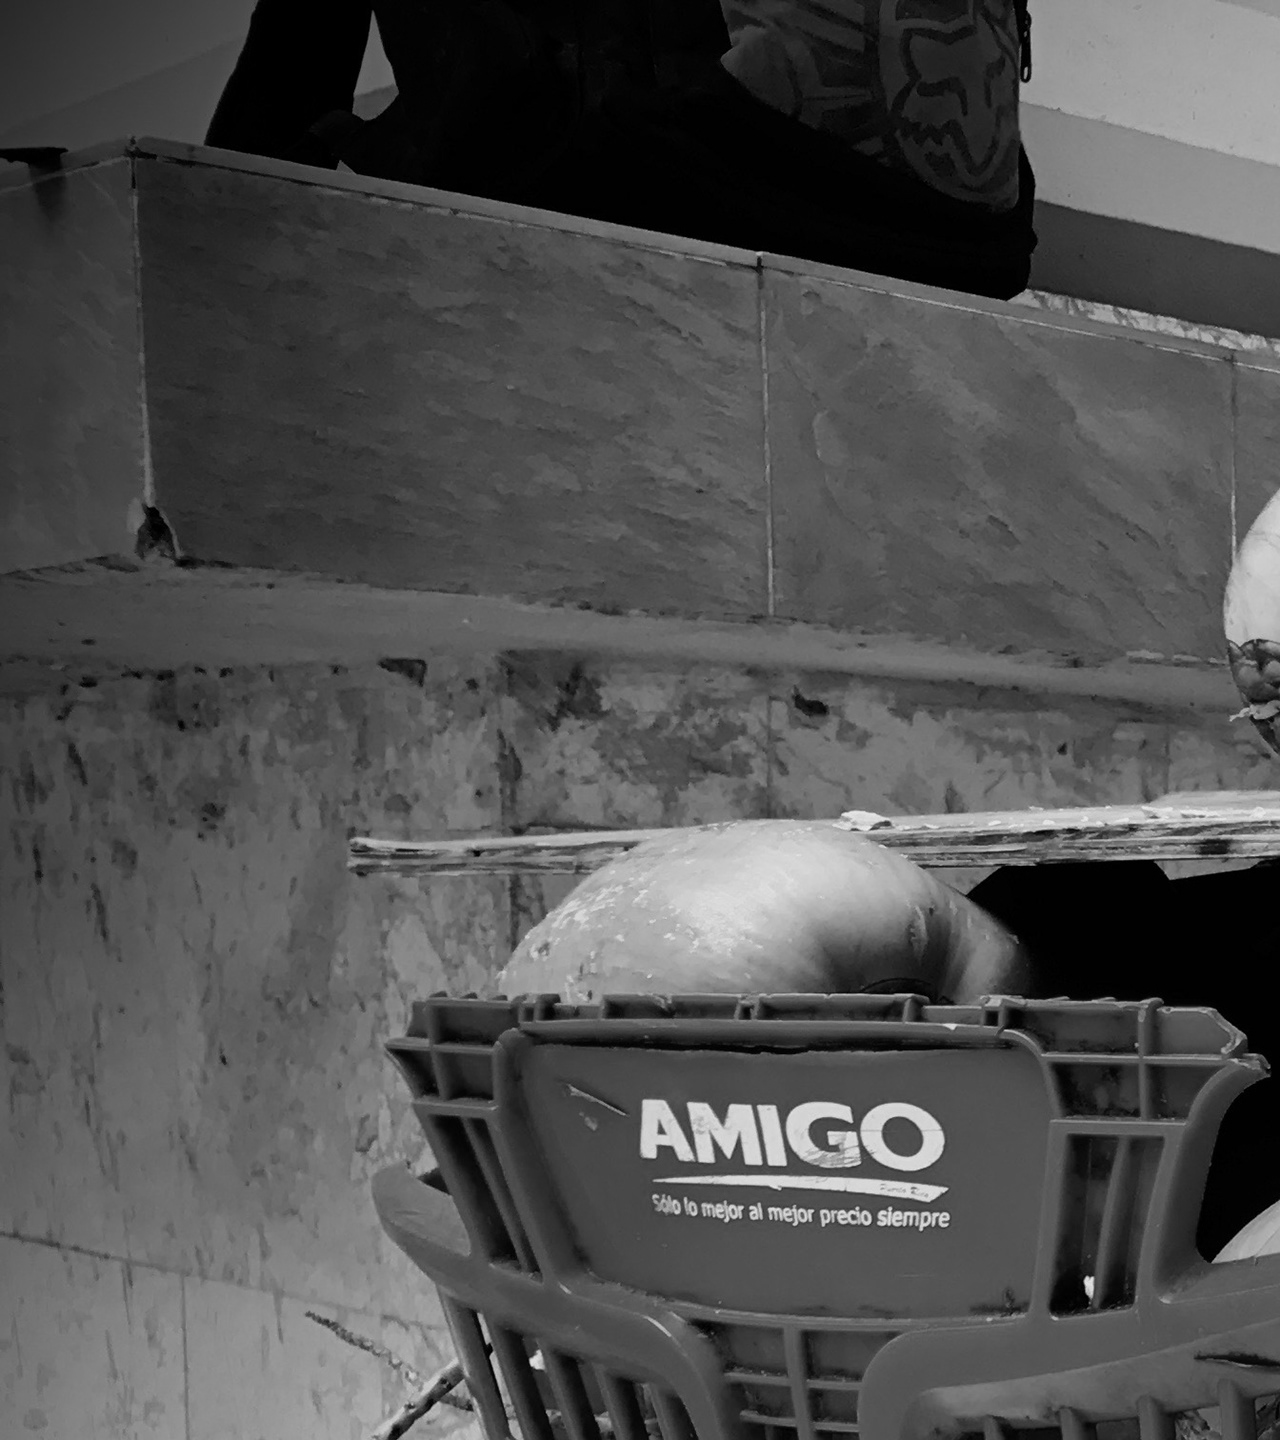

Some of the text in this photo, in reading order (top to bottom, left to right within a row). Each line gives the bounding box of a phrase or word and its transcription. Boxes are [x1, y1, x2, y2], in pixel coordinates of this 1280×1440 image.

[639, 1098, 946, 1172] AMIGO
[683, 1196, 699, 1217] lo
[700, 1199, 745, 1223] mejor
[748, 1202, 764, 1221] al
[767, 1204, 815, 1227] mejor
[819, 1206, 873, 1228] precio
[876, 1206, 951, 1232] siempre
